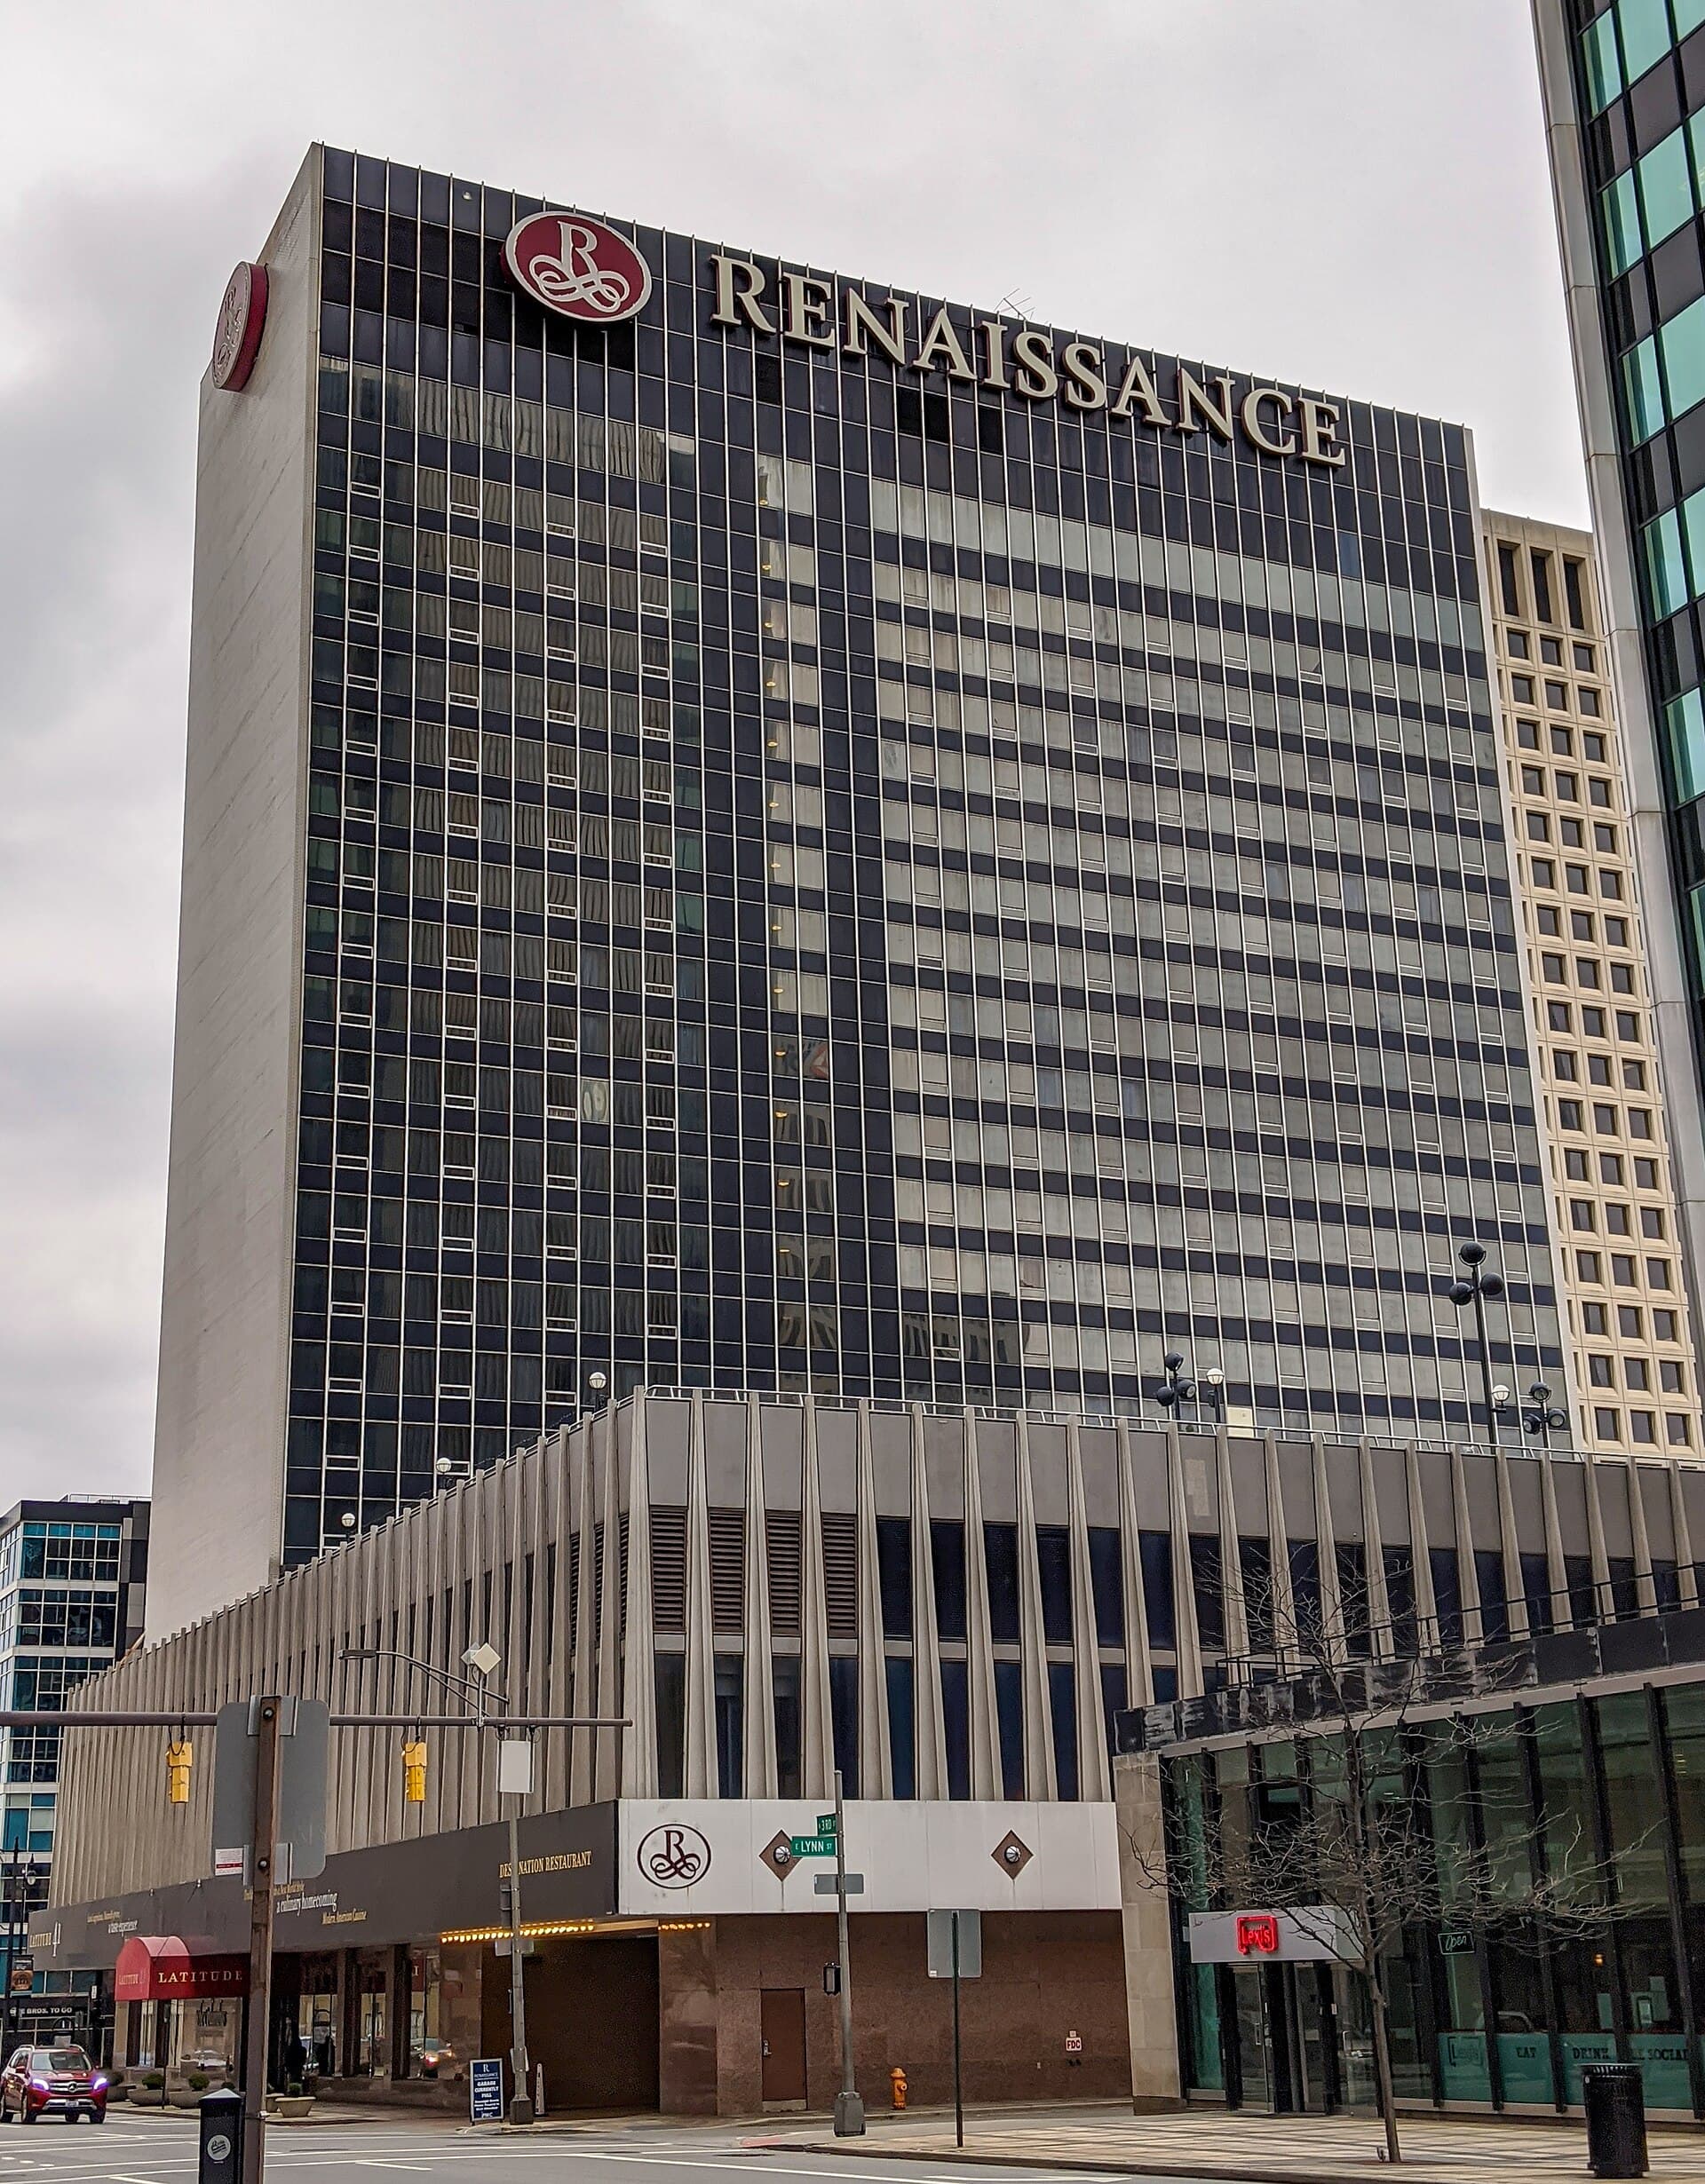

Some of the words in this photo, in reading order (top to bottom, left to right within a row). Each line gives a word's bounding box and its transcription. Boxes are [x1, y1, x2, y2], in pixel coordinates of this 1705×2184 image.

[710, 252, 1347, 468] RENAISSANCE
[801, 1840, 824, 1853] LYNN
[499, 1857, 544, 1878] DESNATION
[545, 1850, 592, 1871] RESTAURANT
[281, 1894, 300, 1917] culinary
[301, 1888, 337, 1912] homecoming
[158, 1970, 242, 1983] LATITUDE
[1516, 2046, 1536, 2058] EAT
[1572, 2047, 1610, 2060] DRINK
[483, 2063, 489, 2072] R
